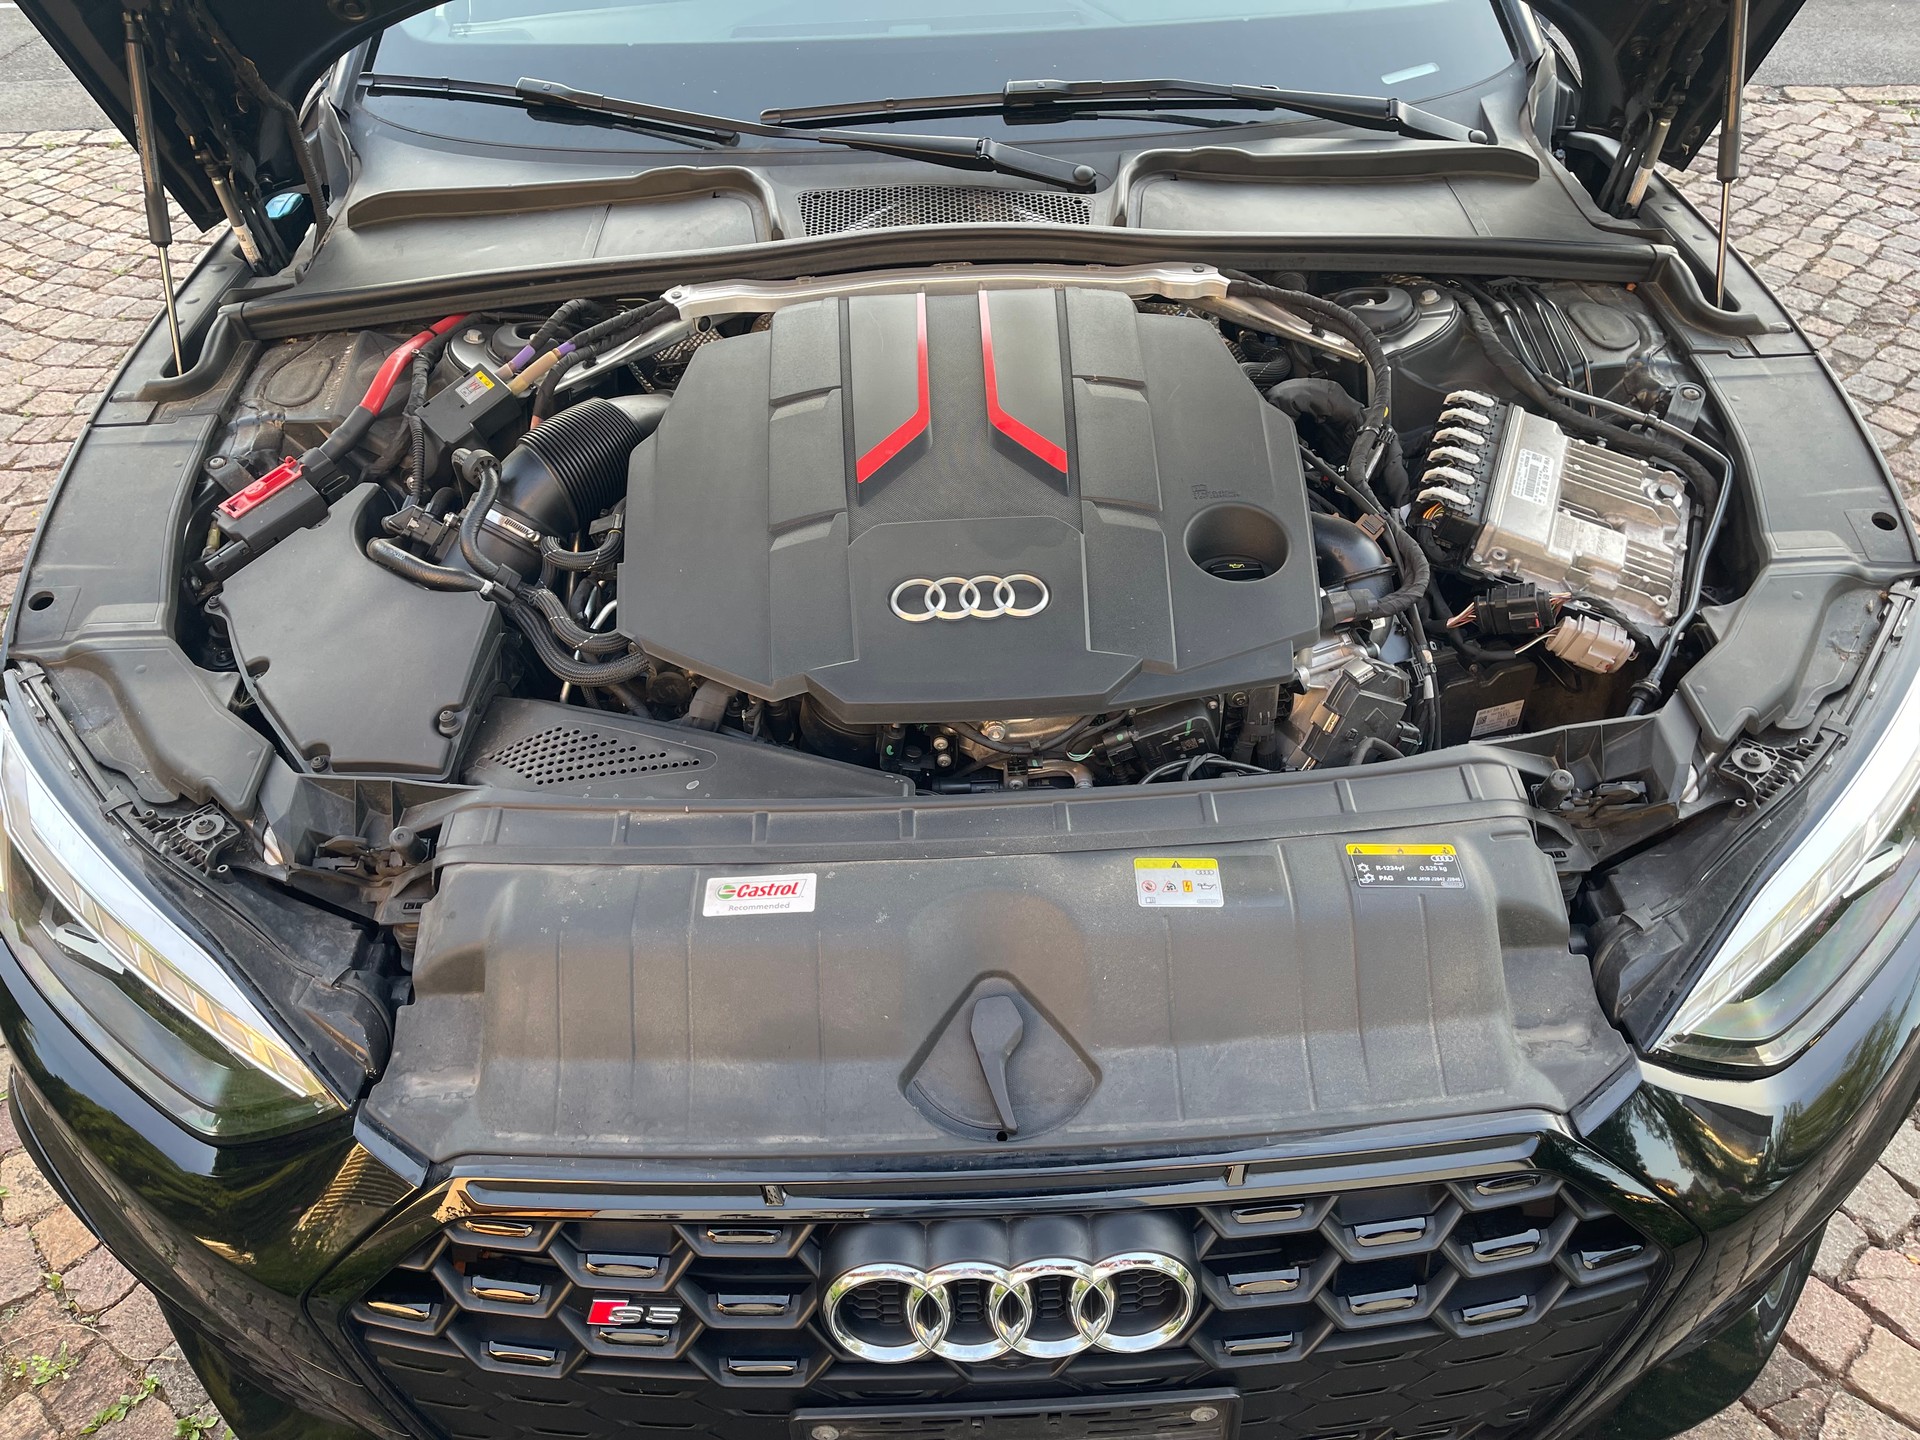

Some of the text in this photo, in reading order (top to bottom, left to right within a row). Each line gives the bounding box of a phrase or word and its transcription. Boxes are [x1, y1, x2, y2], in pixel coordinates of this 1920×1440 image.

[736, 881, 799, 898] Castrol
[728, 902, 791, 911] Recommended
[607, 1306, 681, 1325] S5
